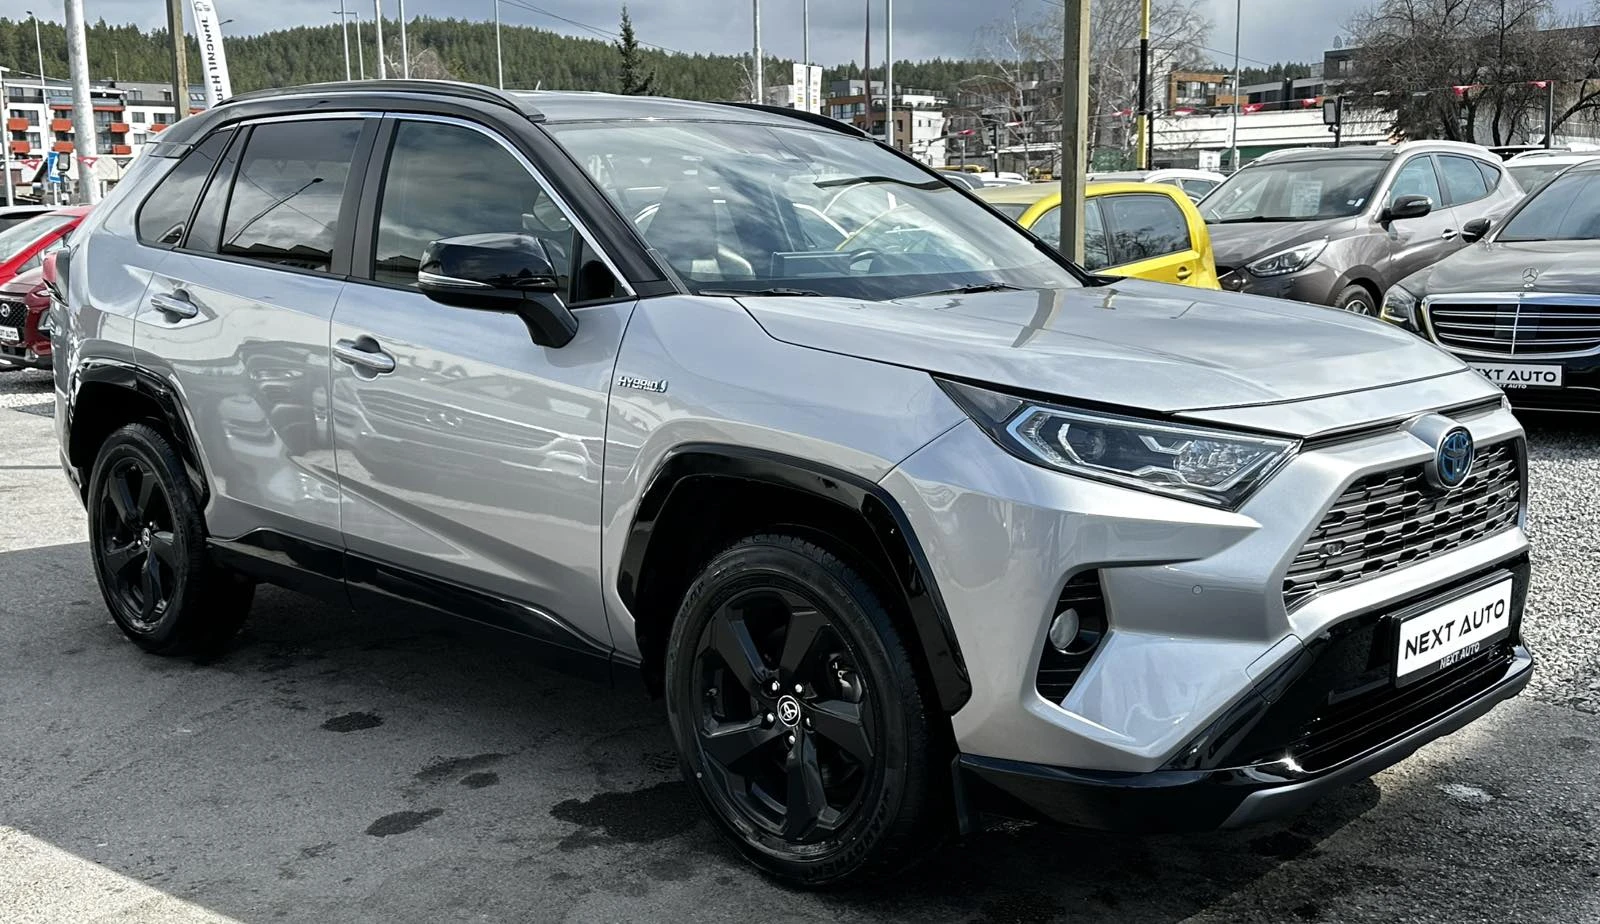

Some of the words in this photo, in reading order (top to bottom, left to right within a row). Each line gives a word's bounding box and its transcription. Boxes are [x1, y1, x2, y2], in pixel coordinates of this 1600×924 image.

[617, 376, 658, 392] HYBRID
[1475, 368, 1504, 380] XT
[1507, 370, 1557, 382] AUTO
[1405, 619, 1455, 660] NEXT
[1458, 598, 1505, 637] AUTO
[1440, 651, 1460, 669] NEXT
[1460, 641, 1480, 659] AUTO
